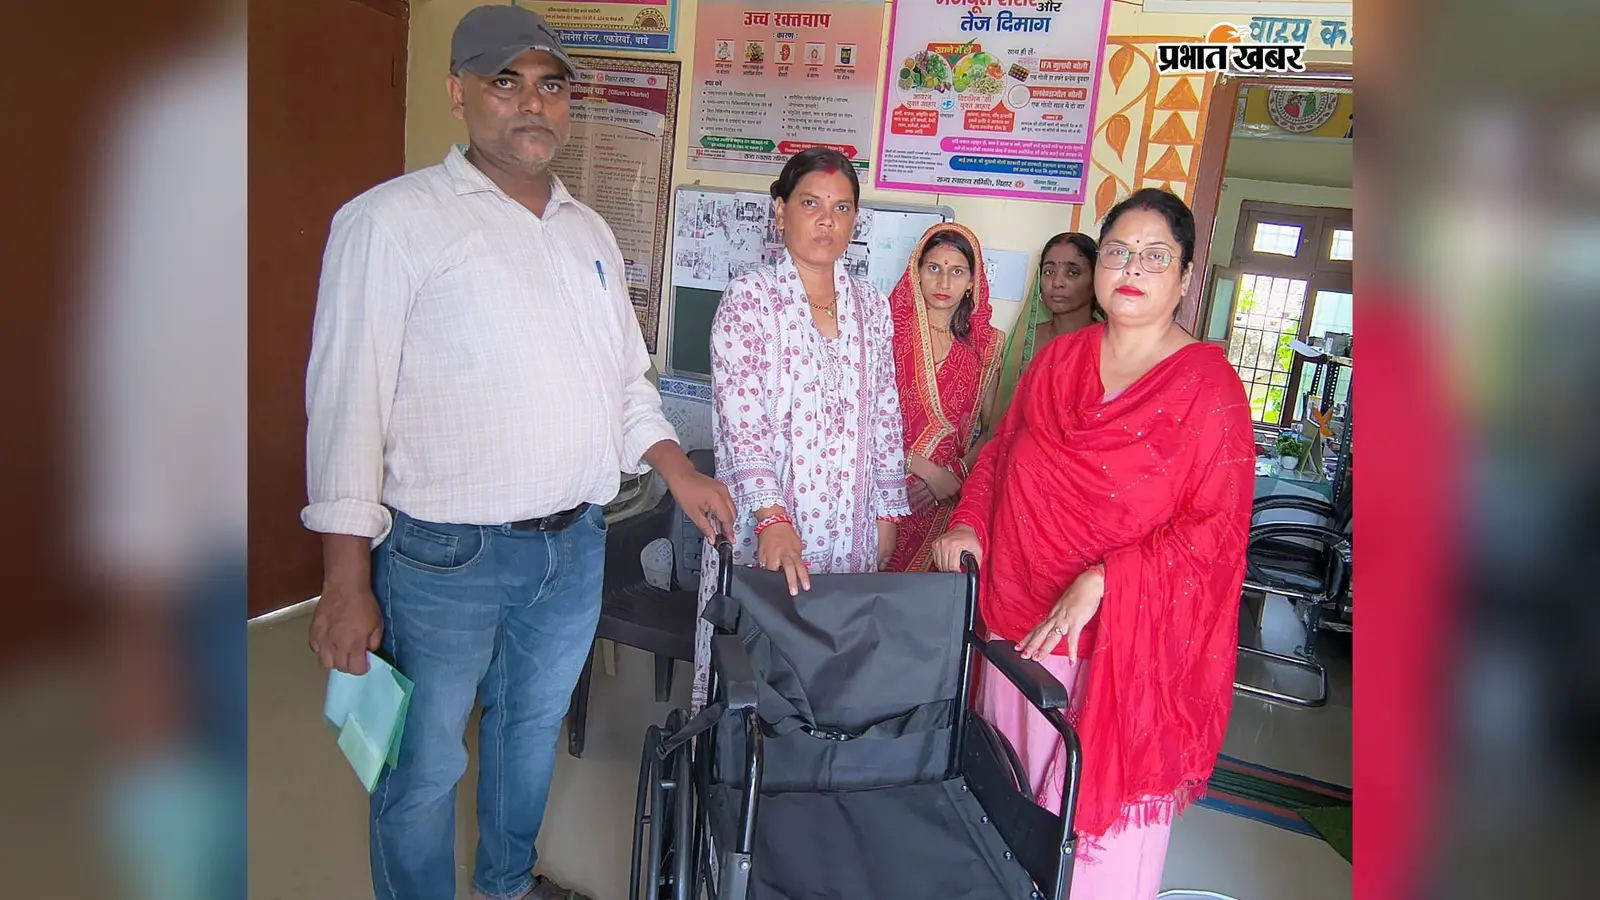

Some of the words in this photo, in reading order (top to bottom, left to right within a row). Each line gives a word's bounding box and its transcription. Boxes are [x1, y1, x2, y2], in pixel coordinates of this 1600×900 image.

[1037, 0, 1062, 12] और
[744, 12, 770, 26] उच्च
[774, 13, 831, 28] रक्तचाप
[961, 11, 992, 31] तेज
[997, 11, 1052, 32] दिमाग
